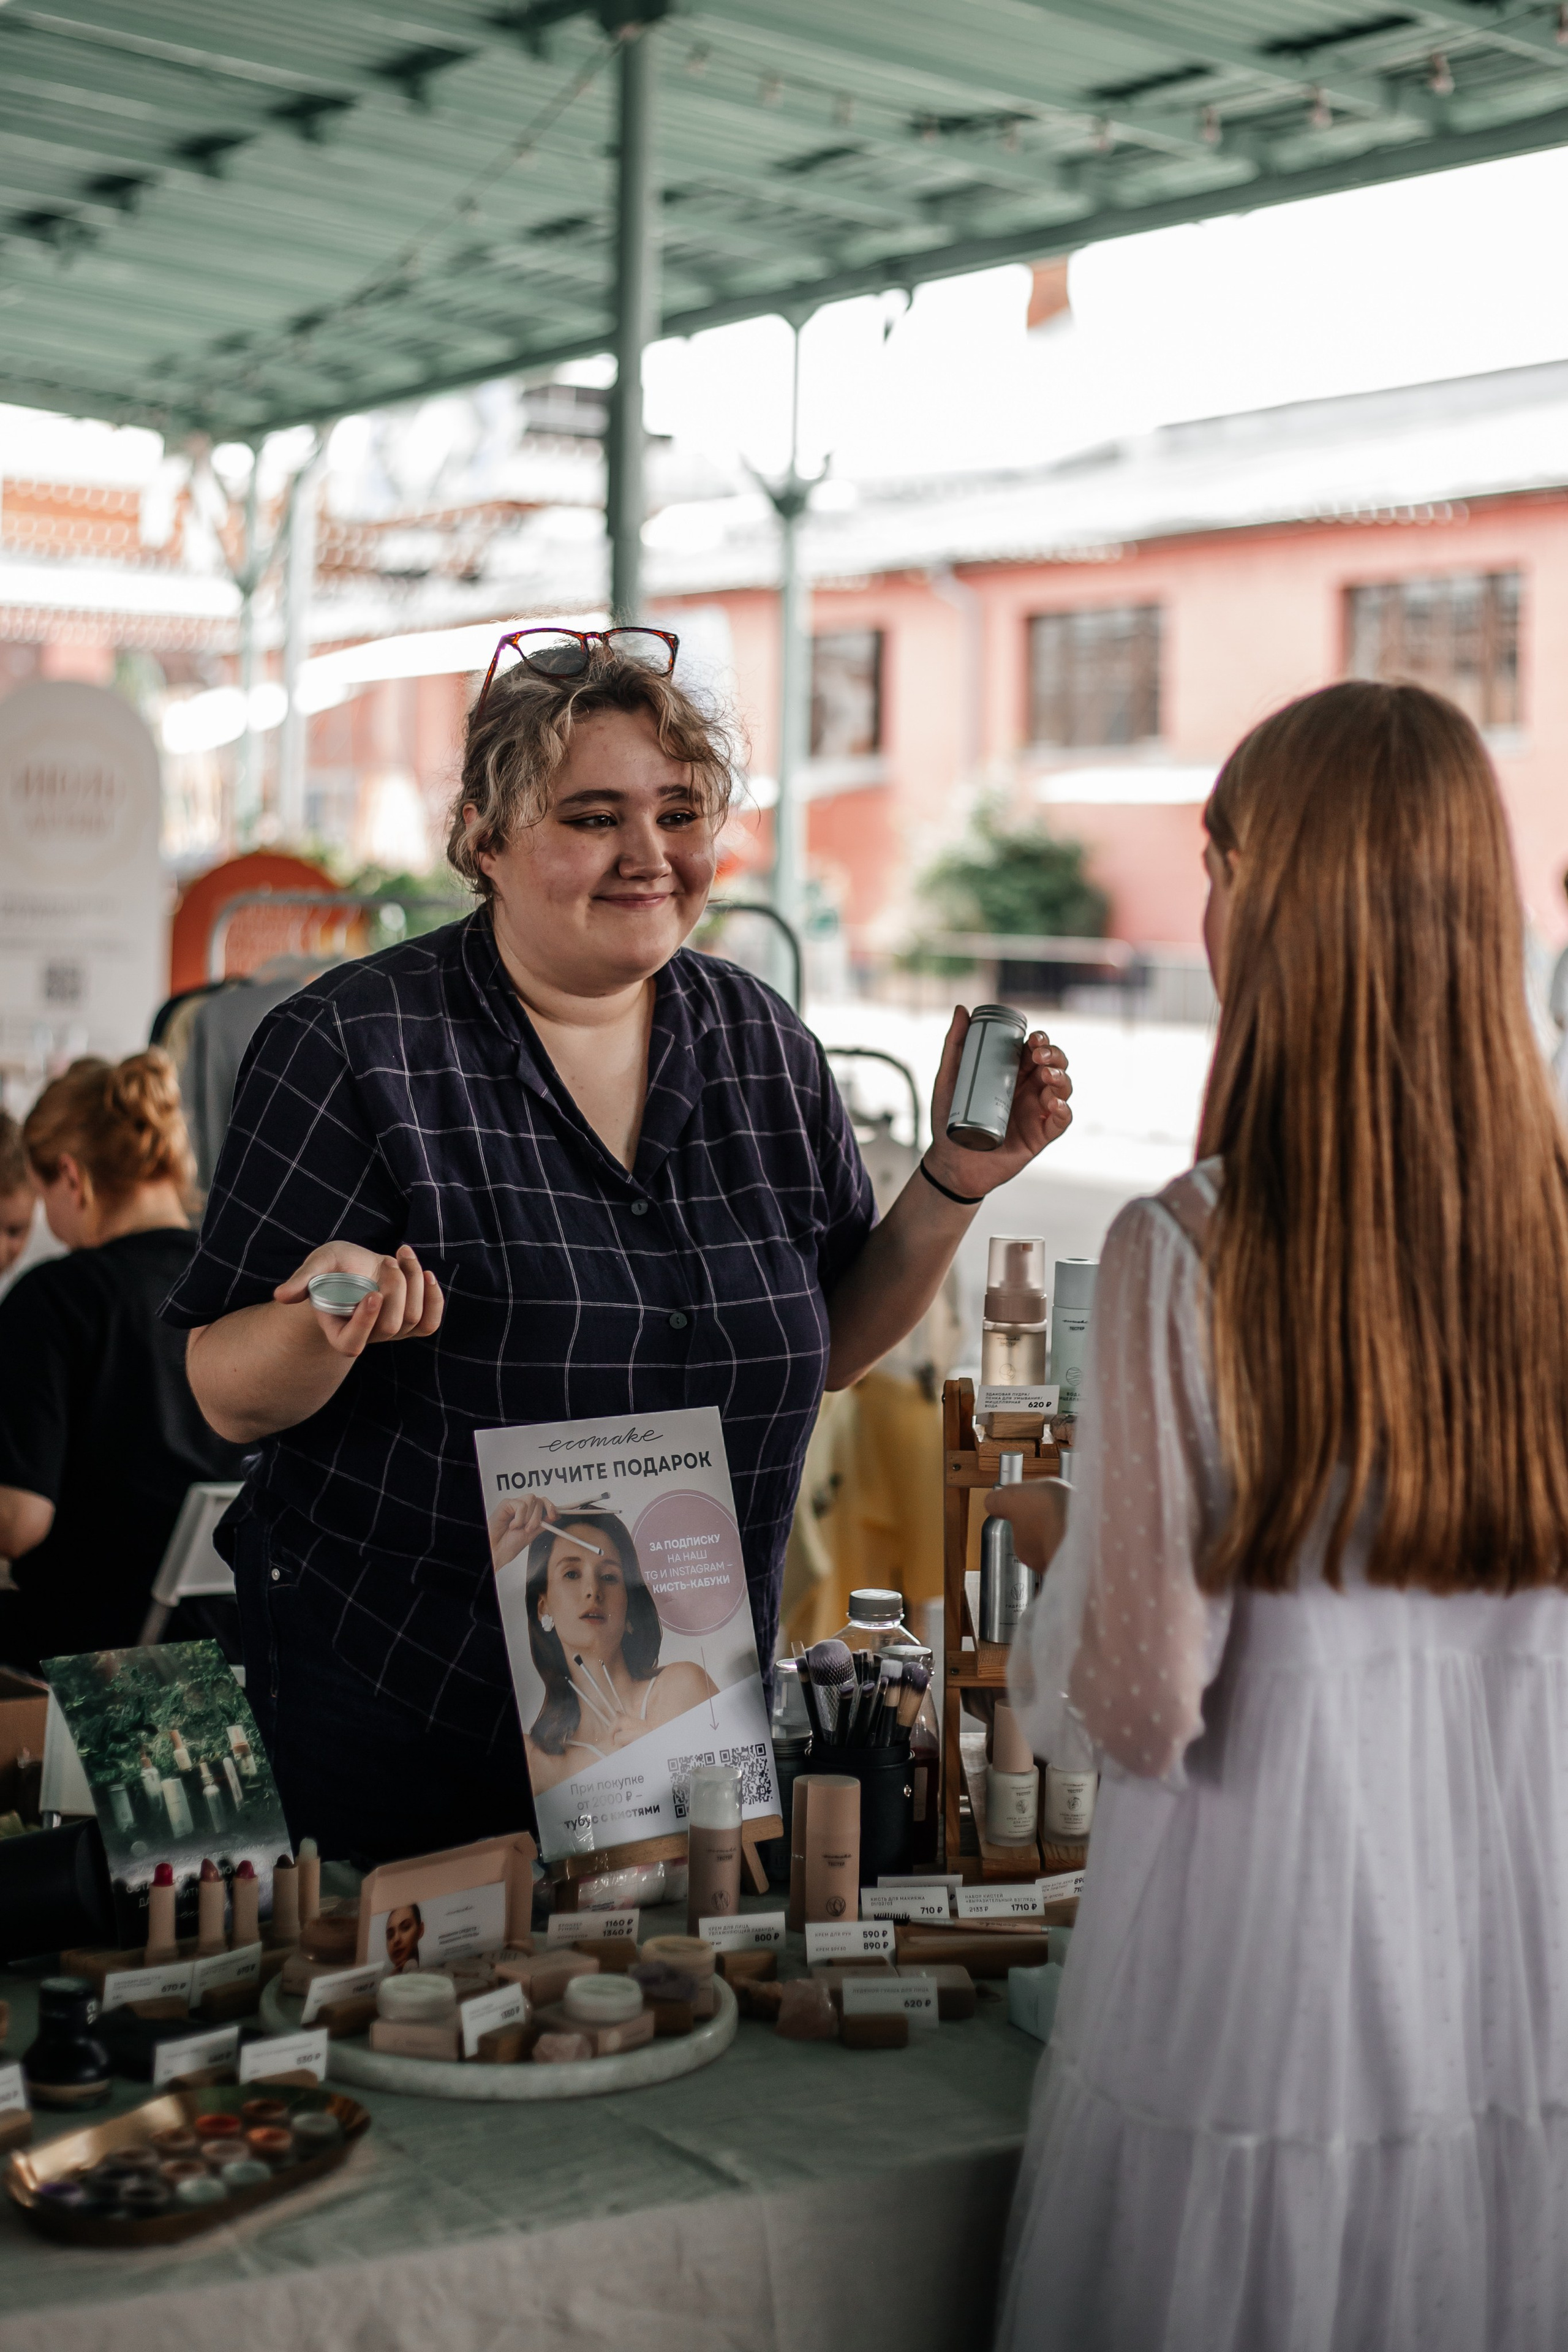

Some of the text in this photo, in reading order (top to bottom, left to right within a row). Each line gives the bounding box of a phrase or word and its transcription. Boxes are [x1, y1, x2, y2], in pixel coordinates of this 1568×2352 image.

[539, 1428, 663, 1452] ecomake
[496, 1451, 712, 1491] ПОЛУЧИТЕ ПОДАРОК
[649, 1534, 720, 1551] ЗА ПОДПИСКУ
[667, 1550, 707, 1563] НА НАШ
[644, 1570, 658, 1581] TG
[661, 1569, 668, 1578] И
[669, 1562, 725, 1578] INSTAGRAM
[652, 1575, 731, 1594] КИСТЬ-КАБУКИ
[570, 1774, 645, 1798] При покупке
[577, 1801, 589, 1811] от
[592, 1793, 622, 1808] 2000
[564, 1804, 661, 1831] тубус с кистями
[606, 1919, 625, 1928] 1160
[755, 1933, 772, 1942] 800
[862, 1930, 880, 1939] 590
[863, 1942, 881, 1950] 890
[161, 1985, 178, 1993] 670
[903, 1999, 923, 2008] 620
